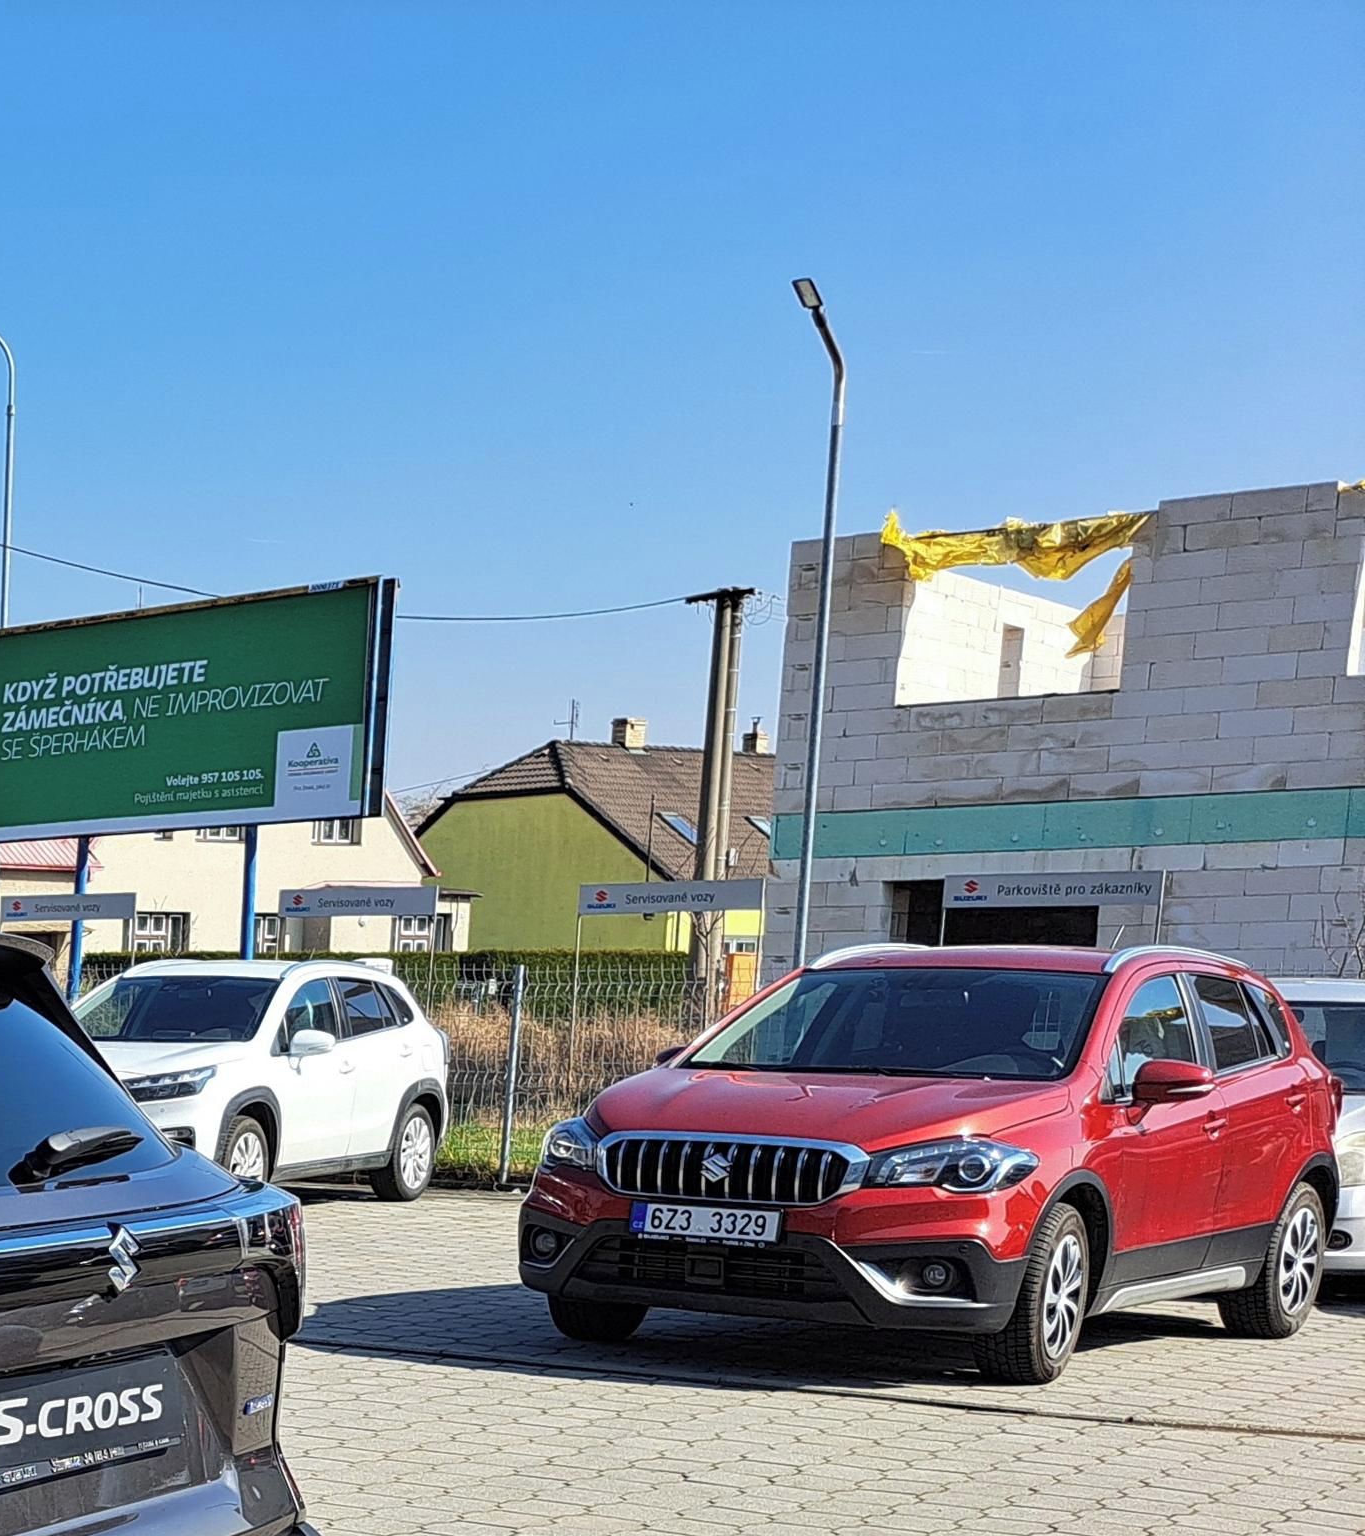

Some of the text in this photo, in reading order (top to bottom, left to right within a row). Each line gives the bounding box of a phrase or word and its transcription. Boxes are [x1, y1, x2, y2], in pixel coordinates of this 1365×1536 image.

[2, 660, 209, 704] KDYŽ POTŘEBUJETE
[1, 697, 127, 733] ZÁMEČNÍKA,
[133, 695, 163, 719] NE
[165, 678, 330, 716] IMPROVIZOVAT
[1, 724, 146, 760] SE ŠPERHÁKEM
[288, 756, 339, 768] Kooperativa
[166, 774, 199, 787] Volejte
[201, 772, 219, 783] 957
[221, 770, 240, 782] 105
[134, 784, 264, 805] Pojištění majetku s asistencí
[625, 890, 716, 905] Servisované vozy
[997, 882, 1153, 897] Parkoviště pro zákazníky
[34, 902, 101, 913] Servisované vozy
[318, 896, 396, 909] Servisované vozy
[650, 1207, 767, 1237] 6Z3 3329
